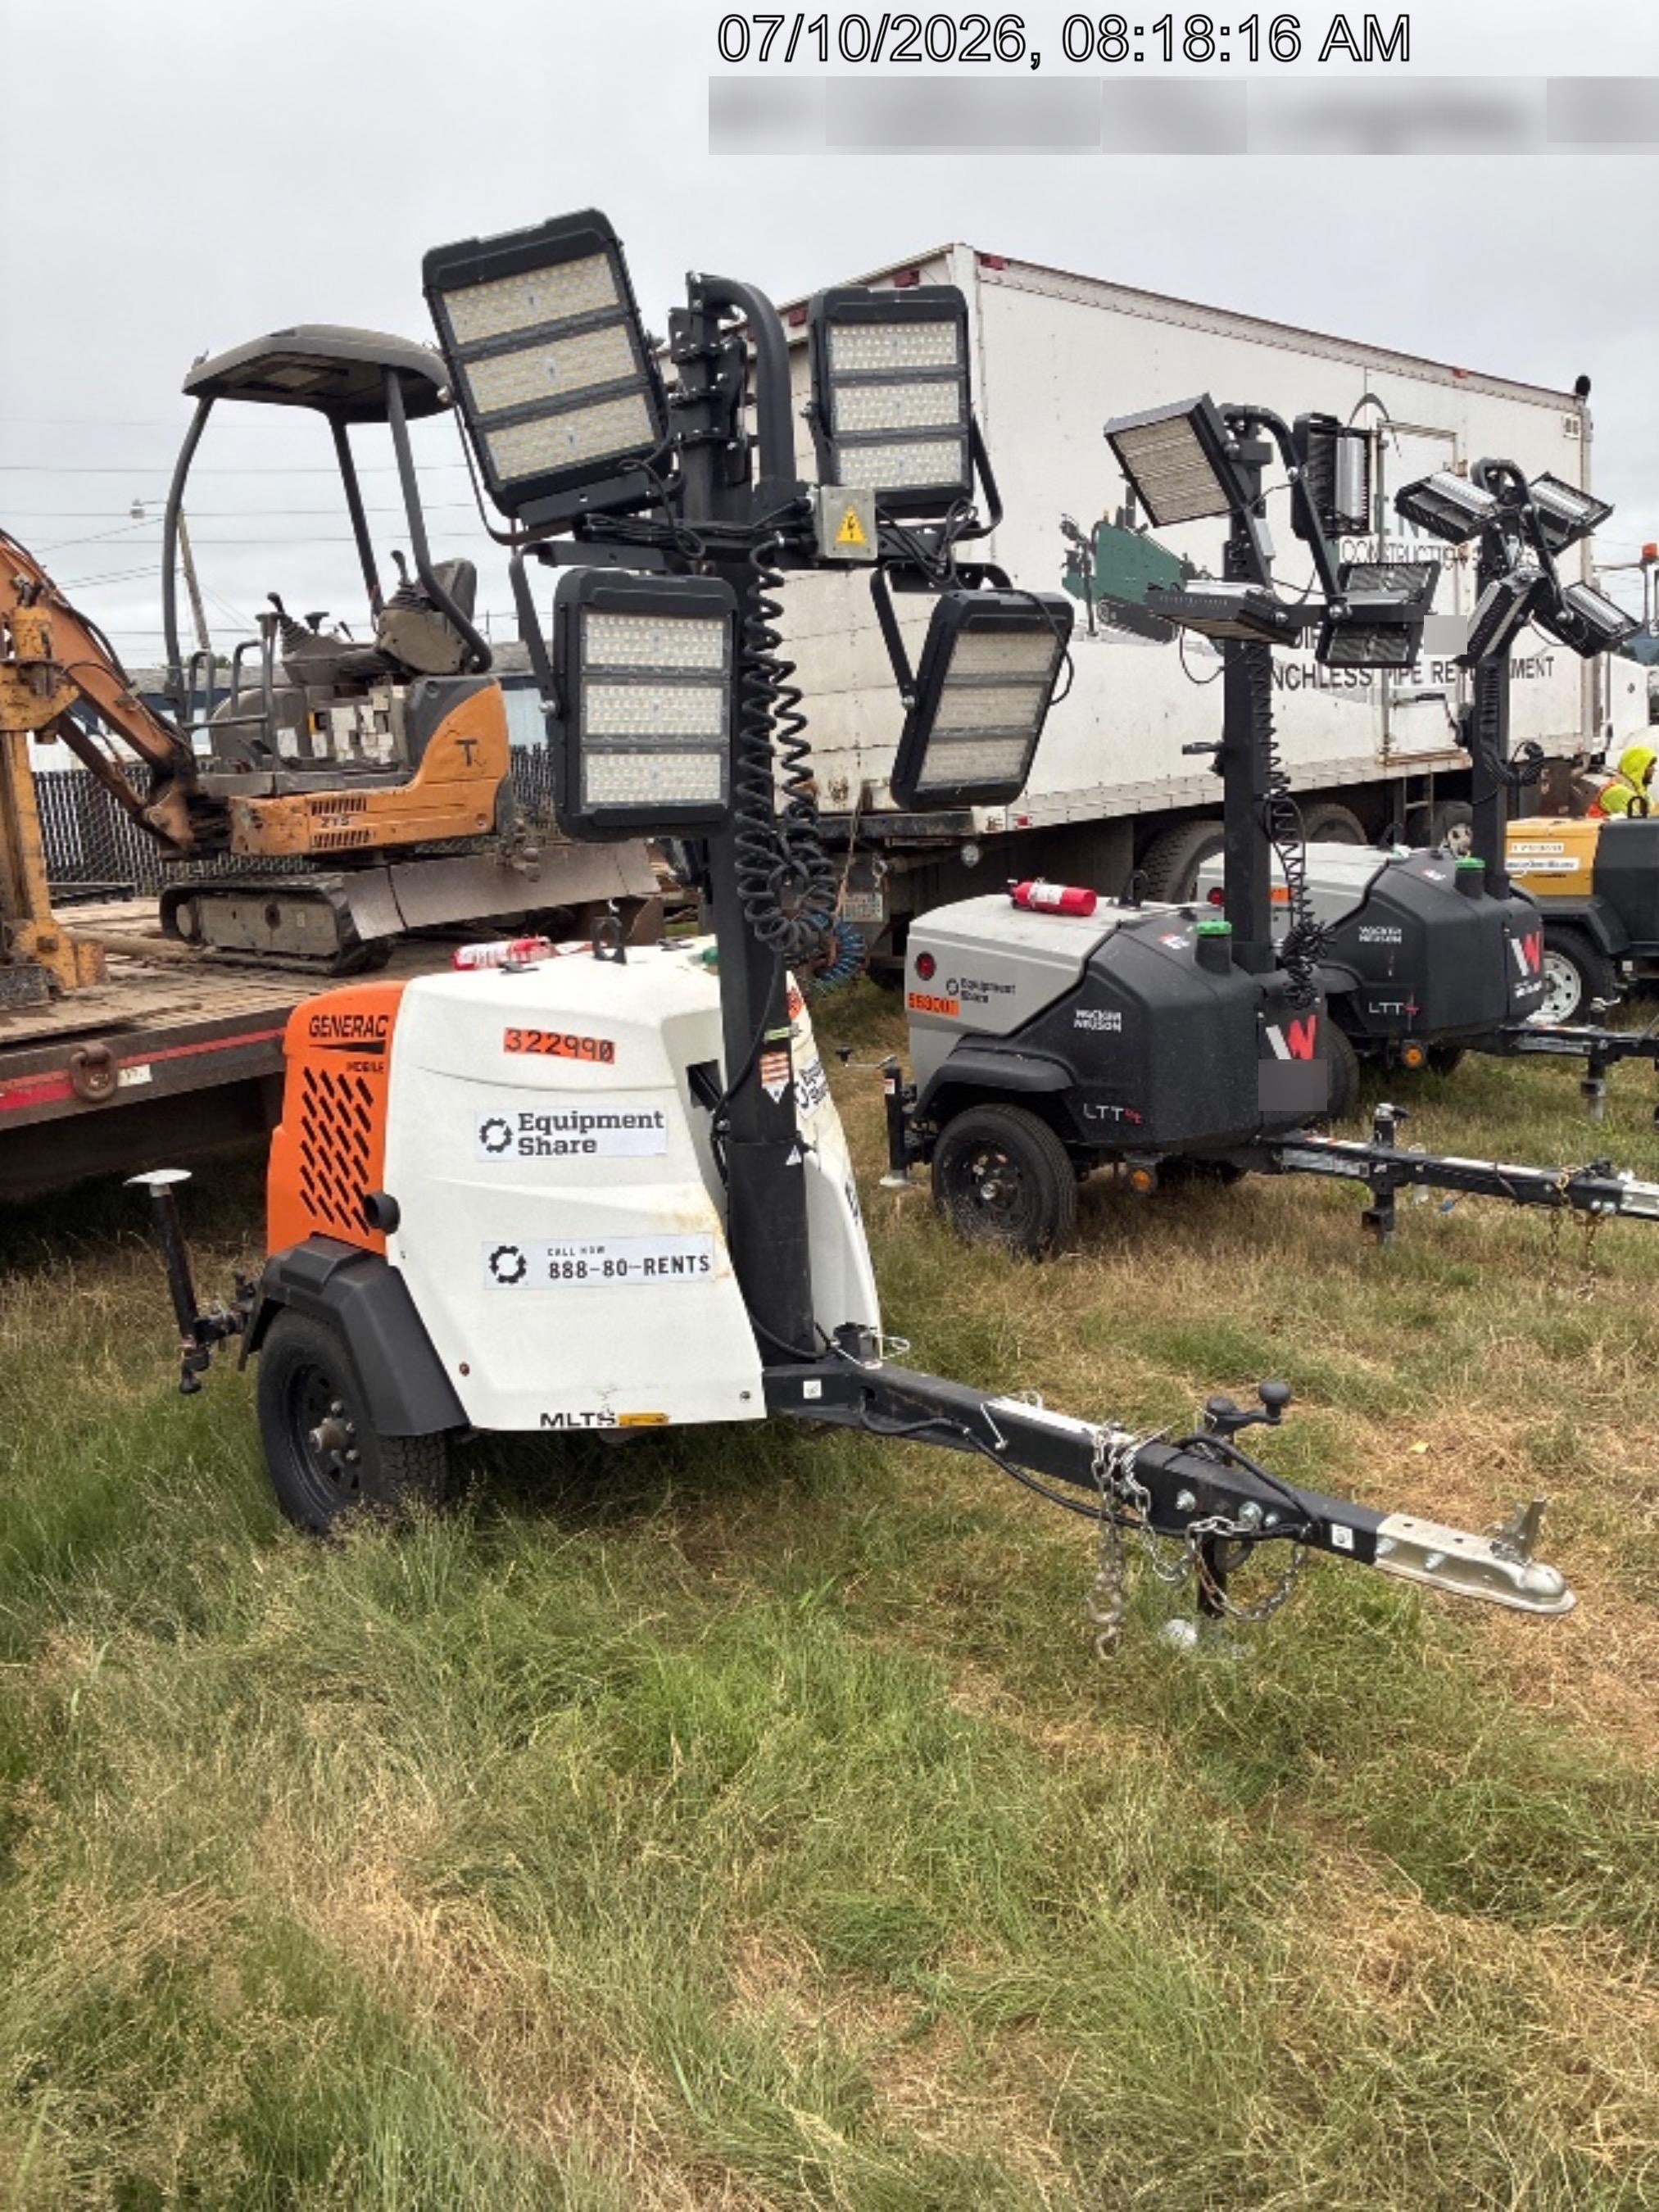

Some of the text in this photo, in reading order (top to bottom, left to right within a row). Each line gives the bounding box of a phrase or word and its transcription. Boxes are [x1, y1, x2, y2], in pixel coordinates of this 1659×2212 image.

[309, 1014, 389, 1038] GENERAC
[505, 1028, 614, 1063] 322990
[346, 1061, 384, 1075] MOBILE
[518, 1110, 665, 1136] Equipment
[518, 1135, 597, 1156] Share
[547, 1245, 605, 1257] CALL NOW
[549, 1255, 711, 1280] 888-80-RENTS
